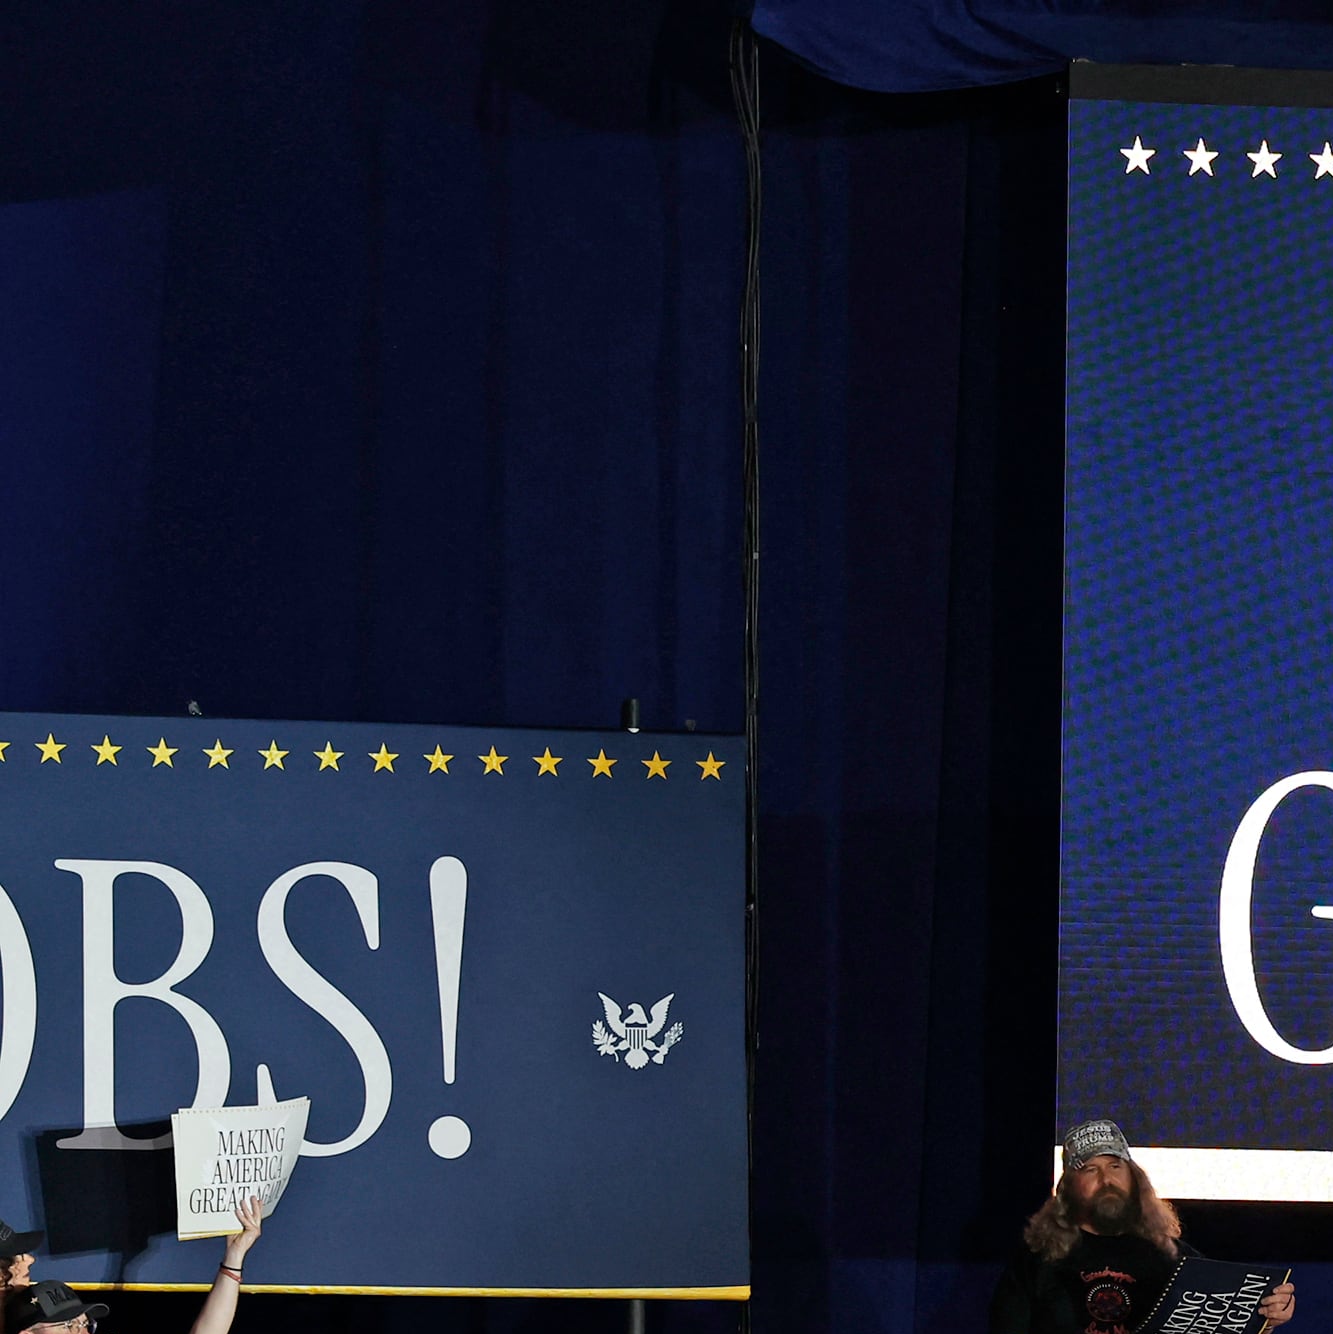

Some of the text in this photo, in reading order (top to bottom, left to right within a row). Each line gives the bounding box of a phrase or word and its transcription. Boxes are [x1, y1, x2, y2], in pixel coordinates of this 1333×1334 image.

[0, 855, 472, 1160] BS!
[217, 1126, 285, 1156] MAKING
[189, 1186, 250, 1214] GREAT
[1226, 1272, 1270, 1334] AGAIN!
